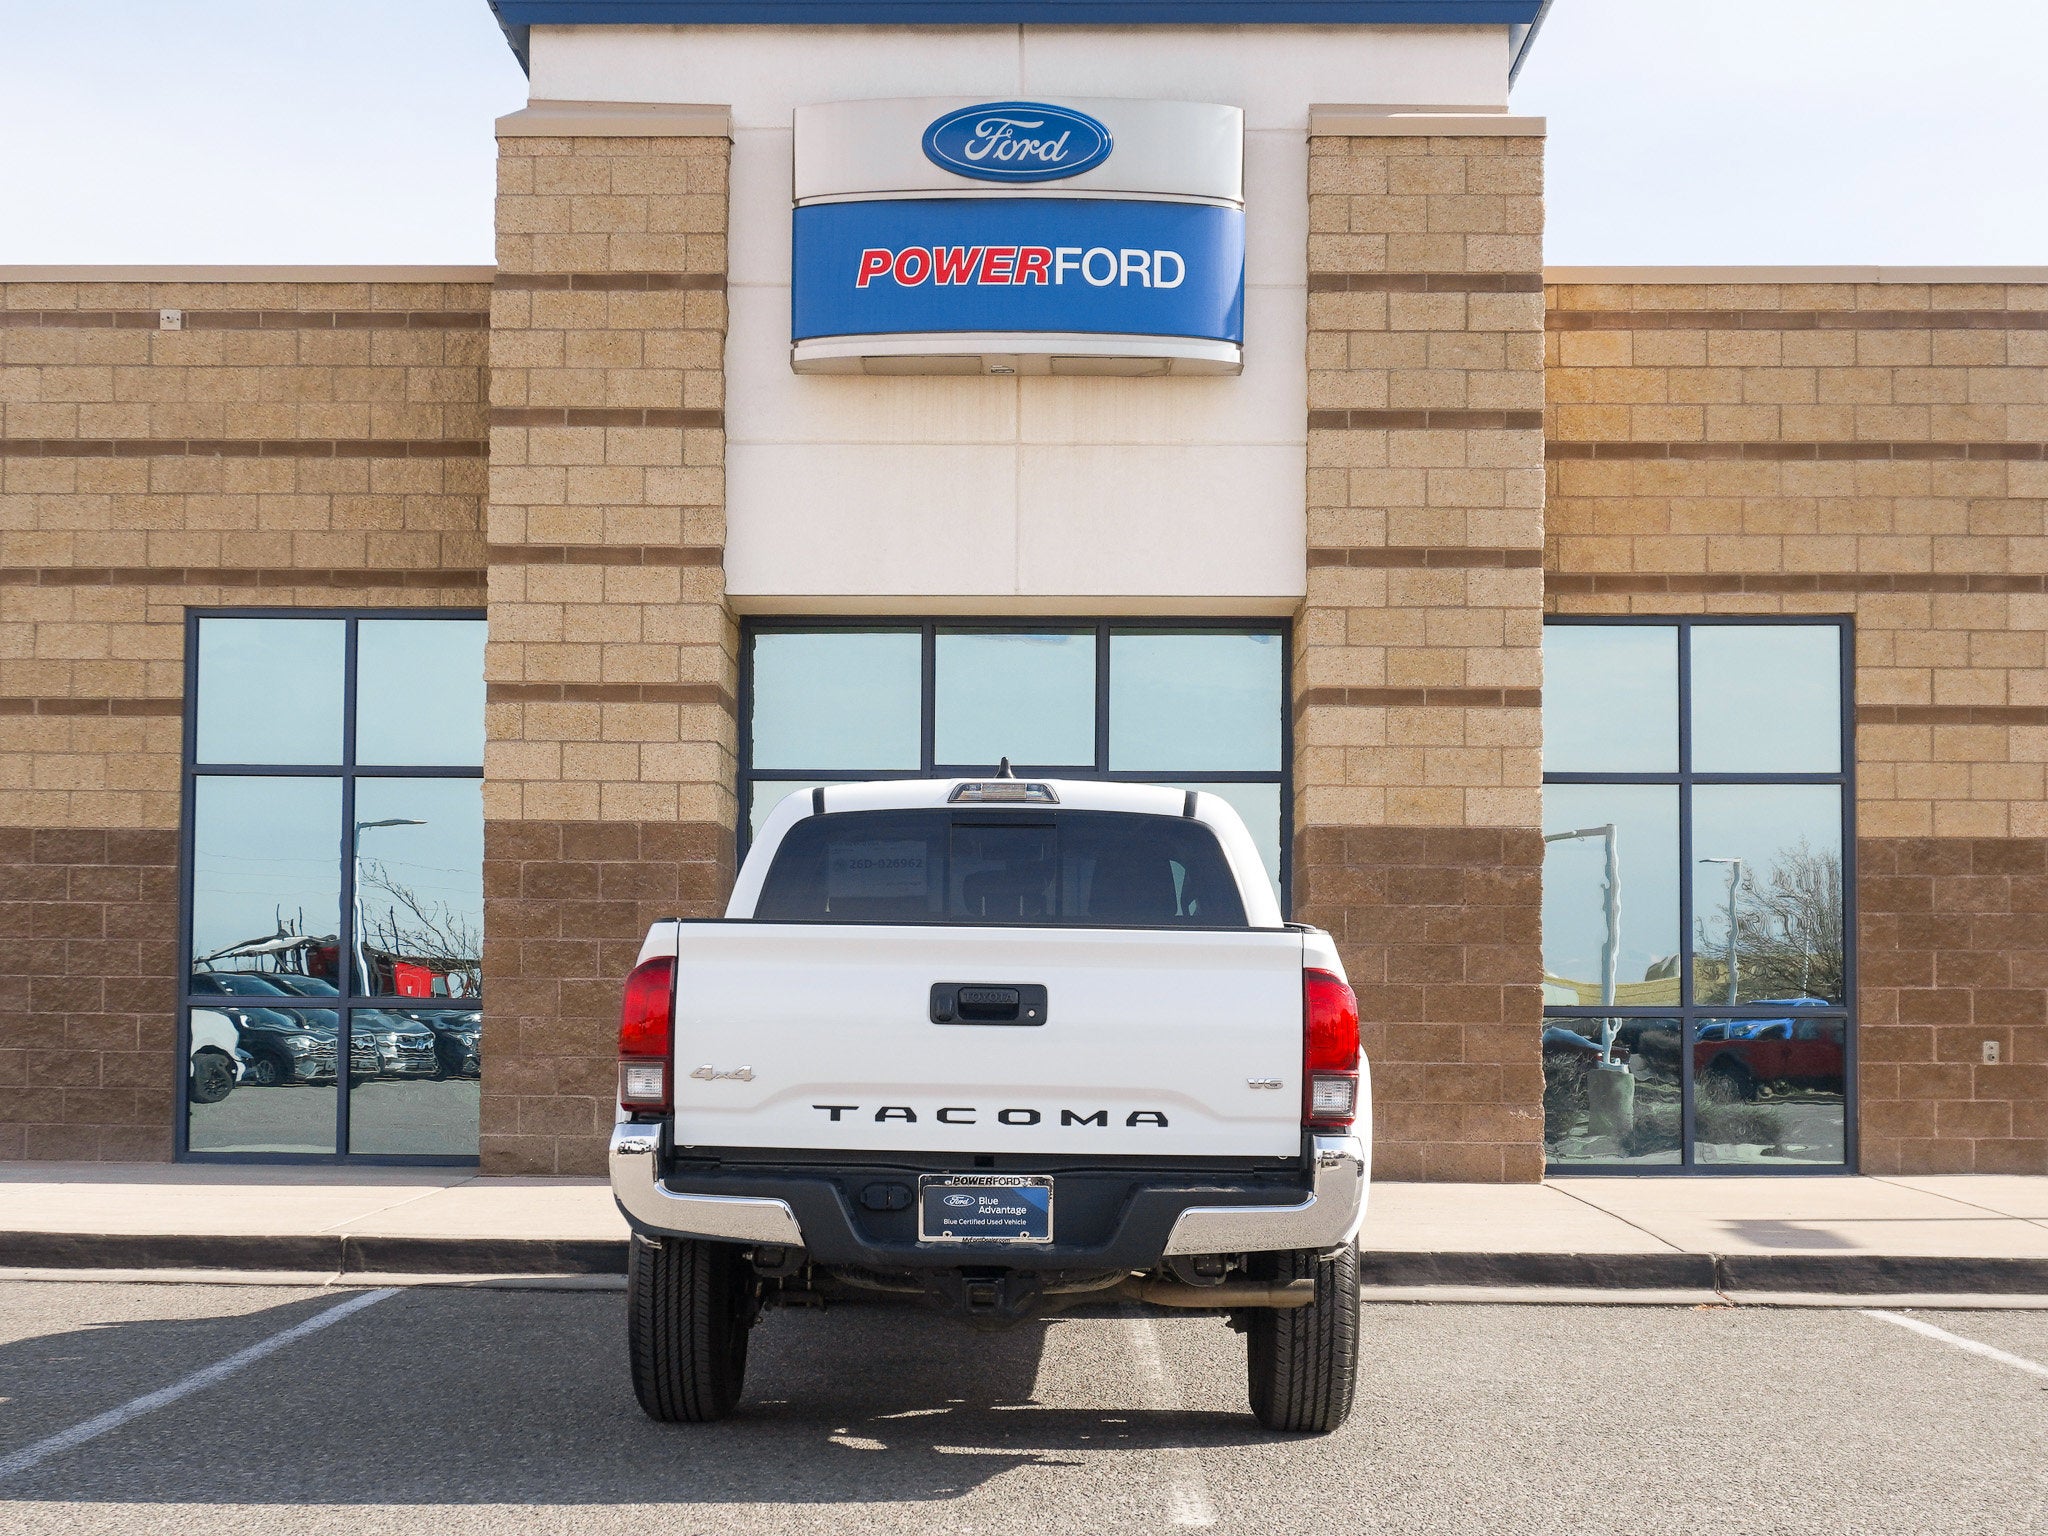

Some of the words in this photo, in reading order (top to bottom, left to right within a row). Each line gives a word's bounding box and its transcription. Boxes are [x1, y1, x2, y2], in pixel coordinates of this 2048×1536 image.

[963, 116, 1072, 163] Ford
[964, 992, 1014, 1002] TOYOTA
[1246, 1078, 1284, 1090] V6
[812, 1104, 1169, 1127] TACOMA
[949, 1195, 970, 1205] Ford
[978, 1197, 999, 1205] Blue
[978, 1206, 1027, 1215] Advantage
